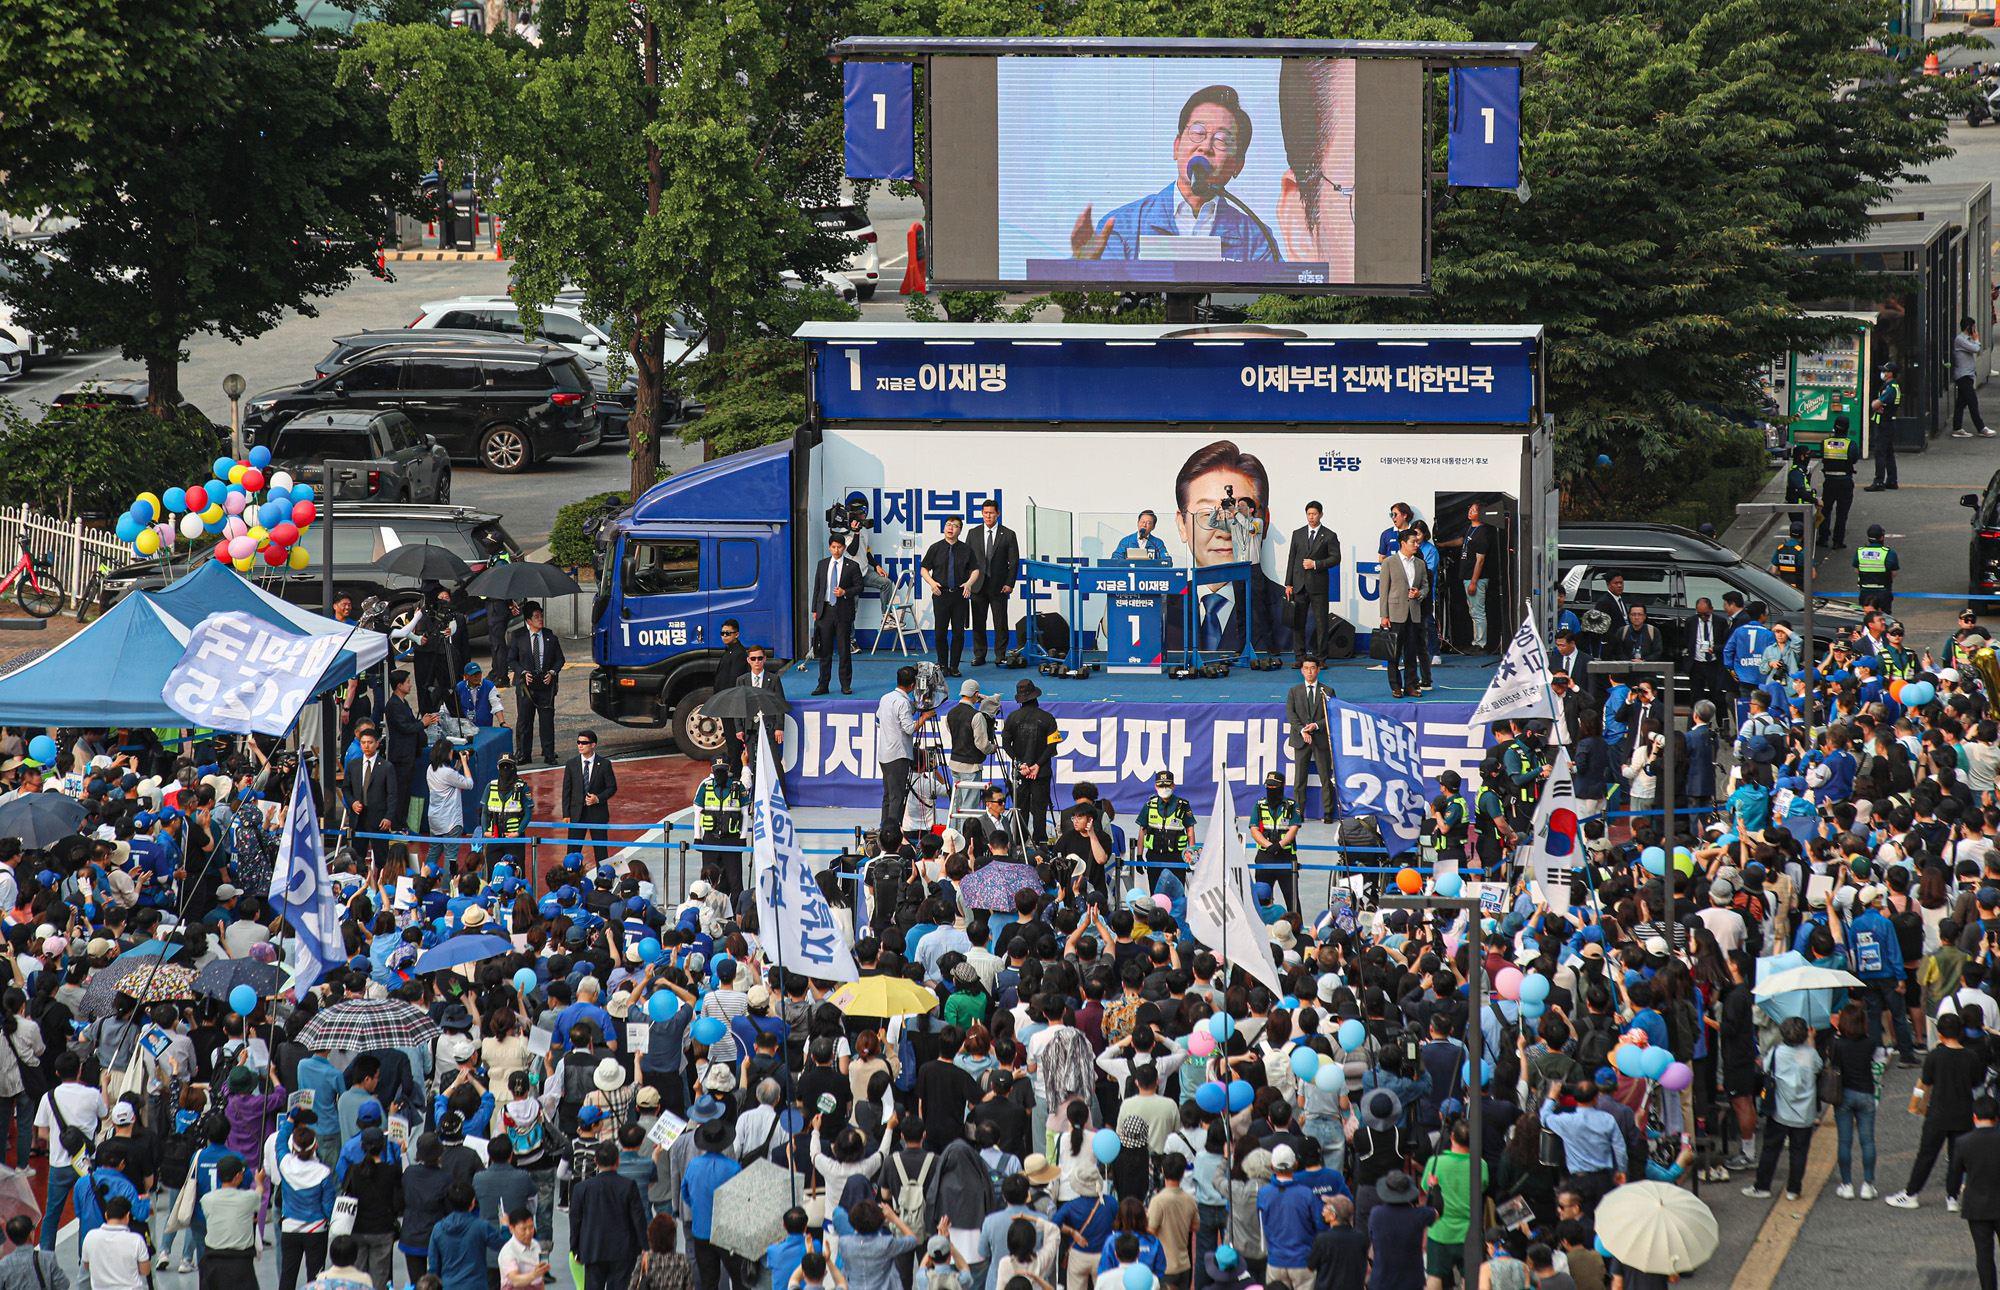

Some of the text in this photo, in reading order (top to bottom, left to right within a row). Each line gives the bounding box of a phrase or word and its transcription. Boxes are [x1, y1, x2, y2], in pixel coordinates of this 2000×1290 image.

[872, 93, 886, 130] 1
[1481, 108, 1495, 144] 1
[1298, 274, 1325, 284] 민주당
[844, 348, 1007, 392] 1 지금은 이재명
[1240, 364, 1495, 393] 이제부터 진짜 대한민국
[1318, 456, 1362, 472] 민주당
[1380, 457, 1489, 465] 더불어민주당 제21대 대통령선거 후보
[1096, 572, 1169, 592] 지금은 1 이재명
[1129, 599, 1154, 608] 대한민국
[620, 623, 687, 647] 1 이재명
[668, 621, 686, 629] 지금은
[1127, 615, 1140, 646] 1
[1747, 629, 1758, 654] 1
[1055, 716, 1192, 786] 진짜
[208, 1168, 218, 1192] 1
